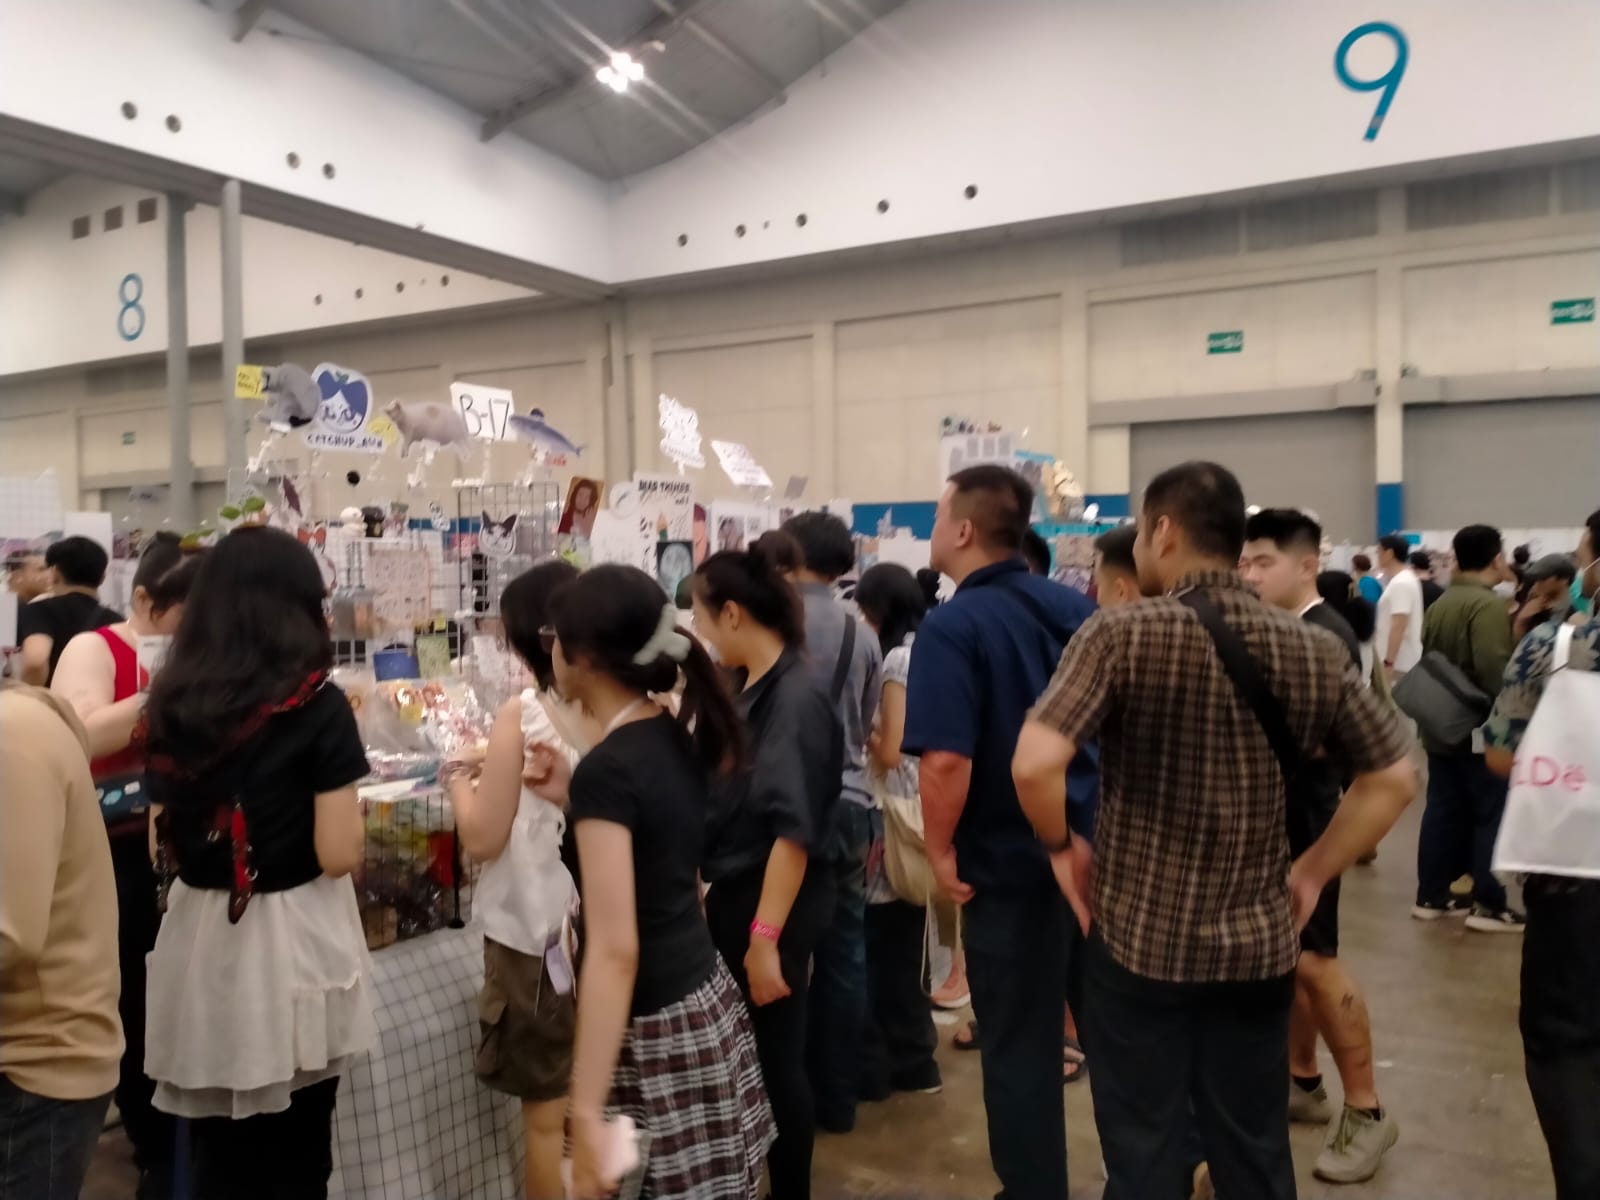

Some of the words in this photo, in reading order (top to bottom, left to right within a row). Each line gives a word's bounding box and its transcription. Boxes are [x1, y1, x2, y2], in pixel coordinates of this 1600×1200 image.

[1334, 20, 1409, 141] 9
[117, 272, 145, 342] 8
[459, 393, 510, 441] B-17
